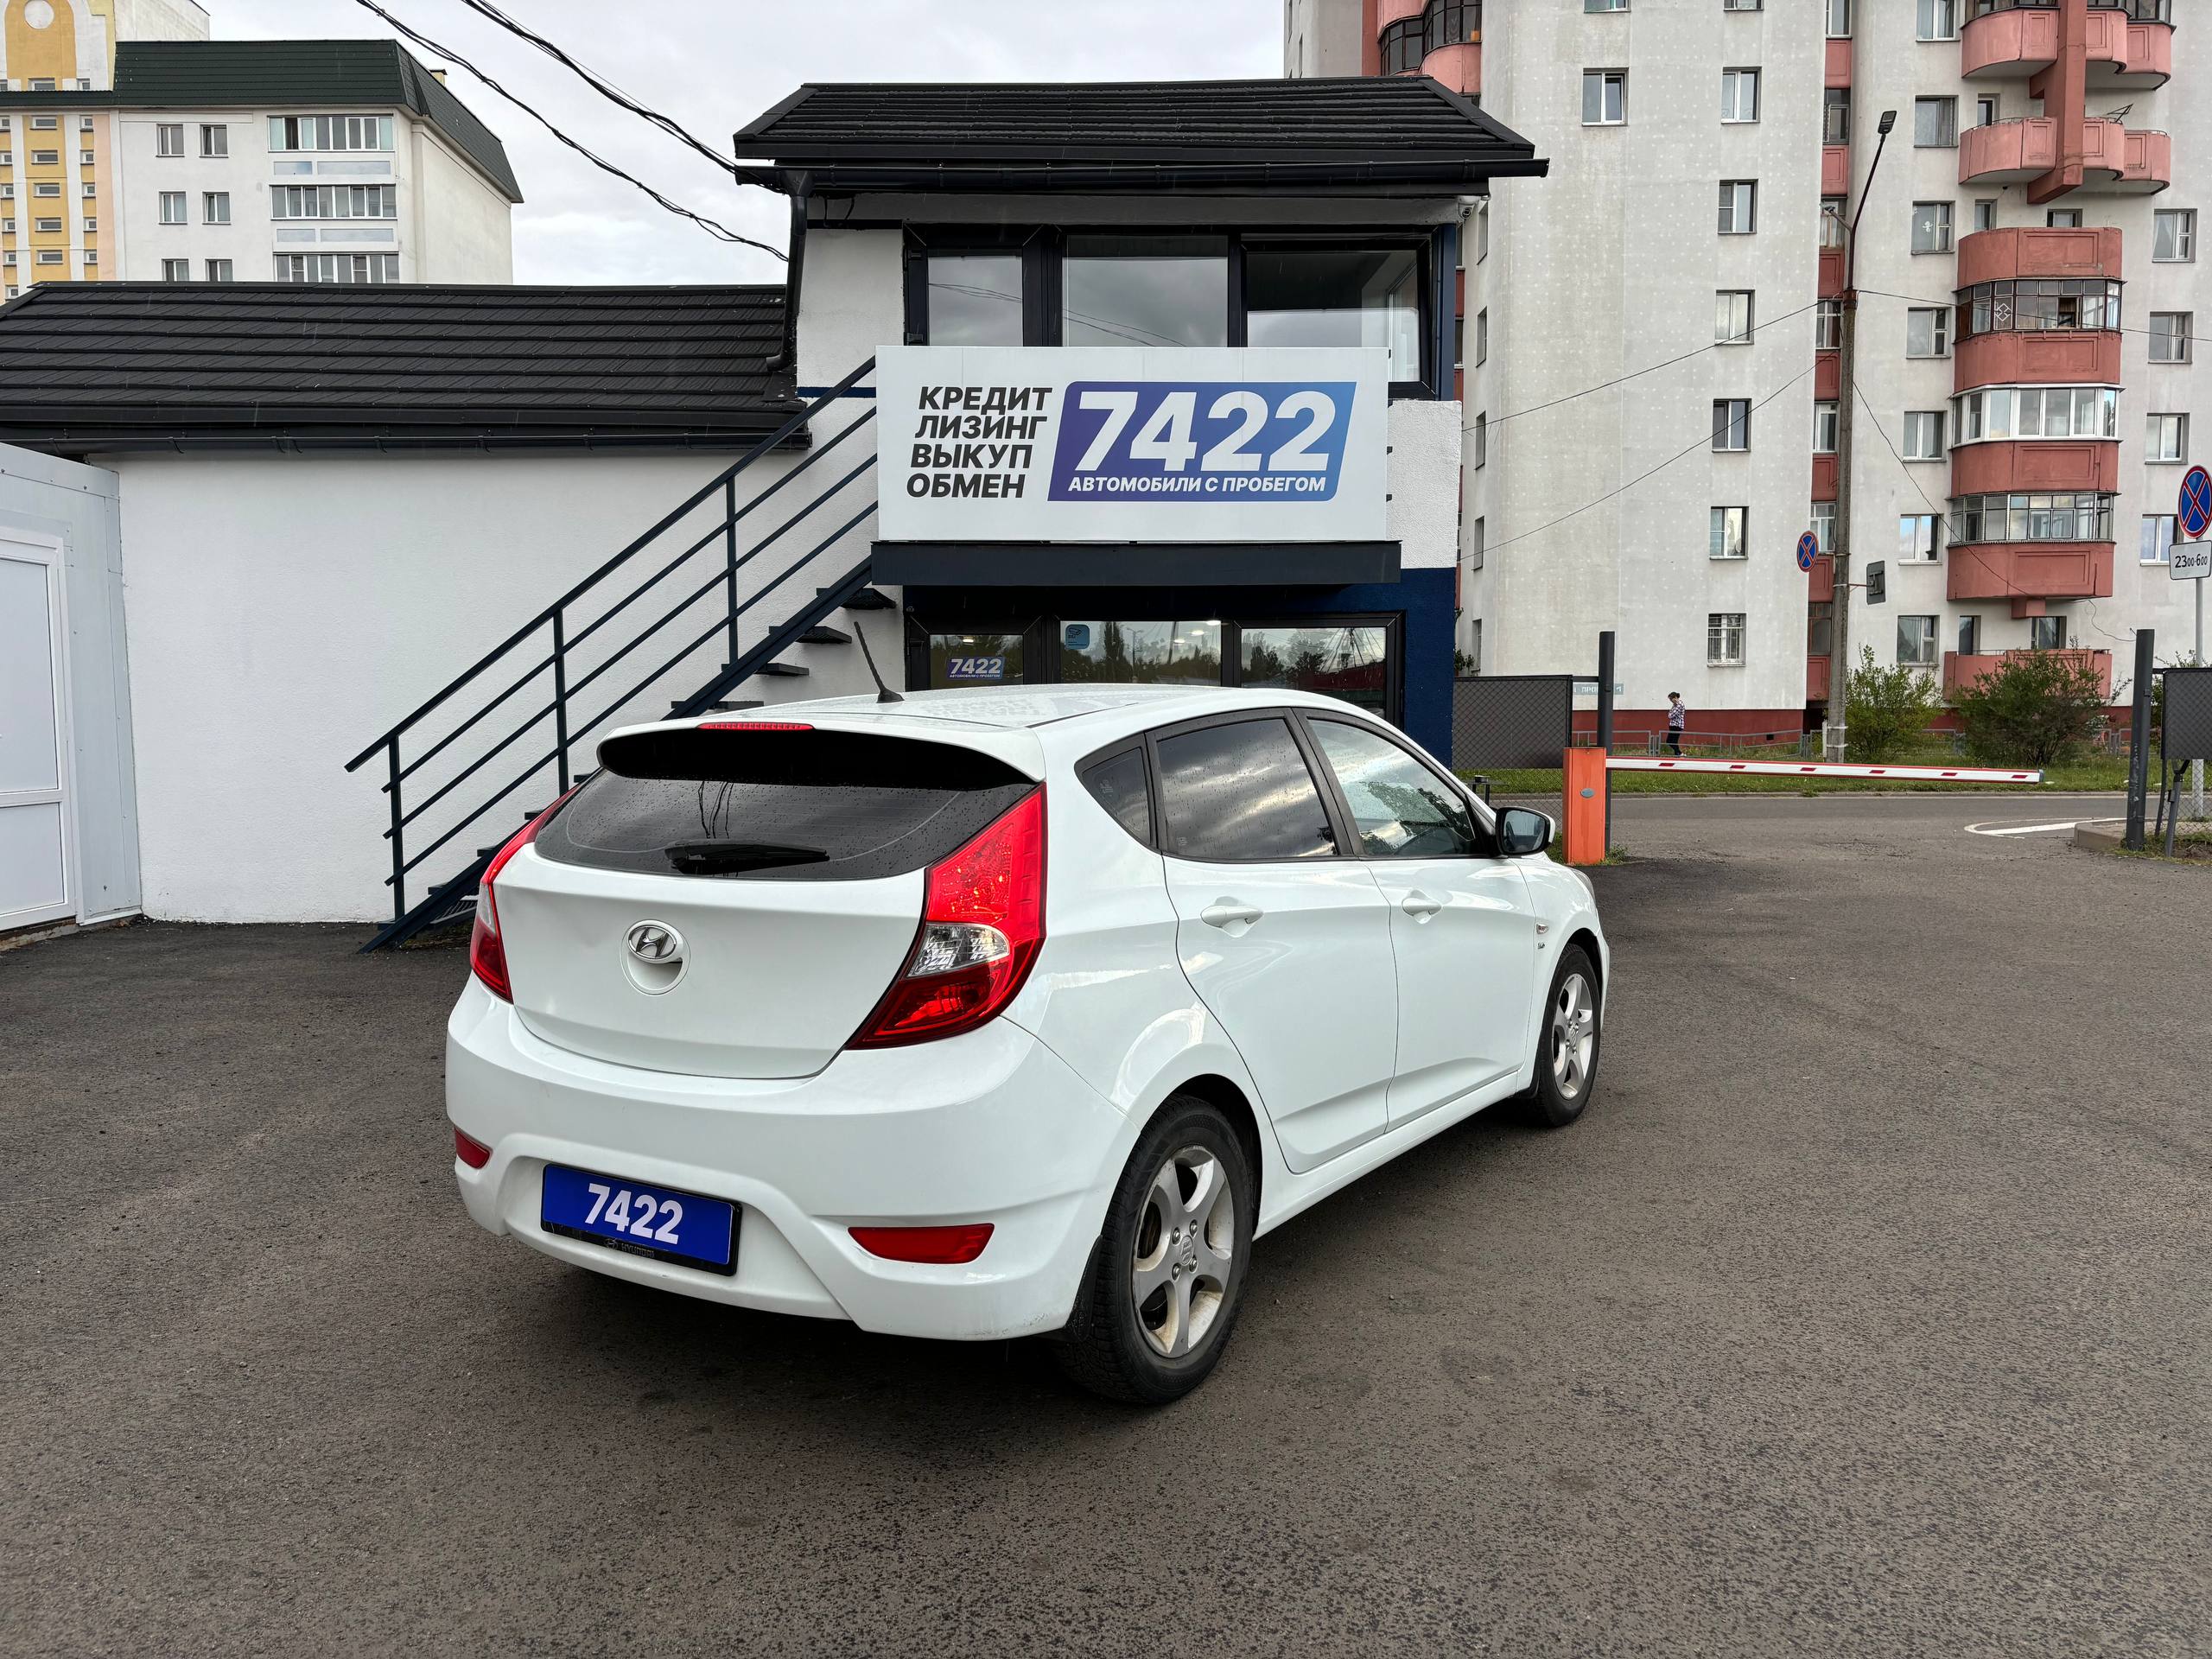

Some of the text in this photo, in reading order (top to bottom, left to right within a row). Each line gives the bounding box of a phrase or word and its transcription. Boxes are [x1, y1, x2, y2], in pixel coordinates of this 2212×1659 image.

[918, 386, 1052, 413] КРЕДИТ
[915, 415, 1047, 439] ЛИЗИНГ
[1075, 391, 1336, 471] 7422
[911, 444, 1033, 468] ВЫКУП
[906, 474, 1026, 498] ОБМЕН
[1068, 477, 1325, 492] АВТОМОБИЛИ С ПРОБЕГОМ
[950, 658, 1001, 674] 7422
[585, 1183, 683, 1244] 7422
